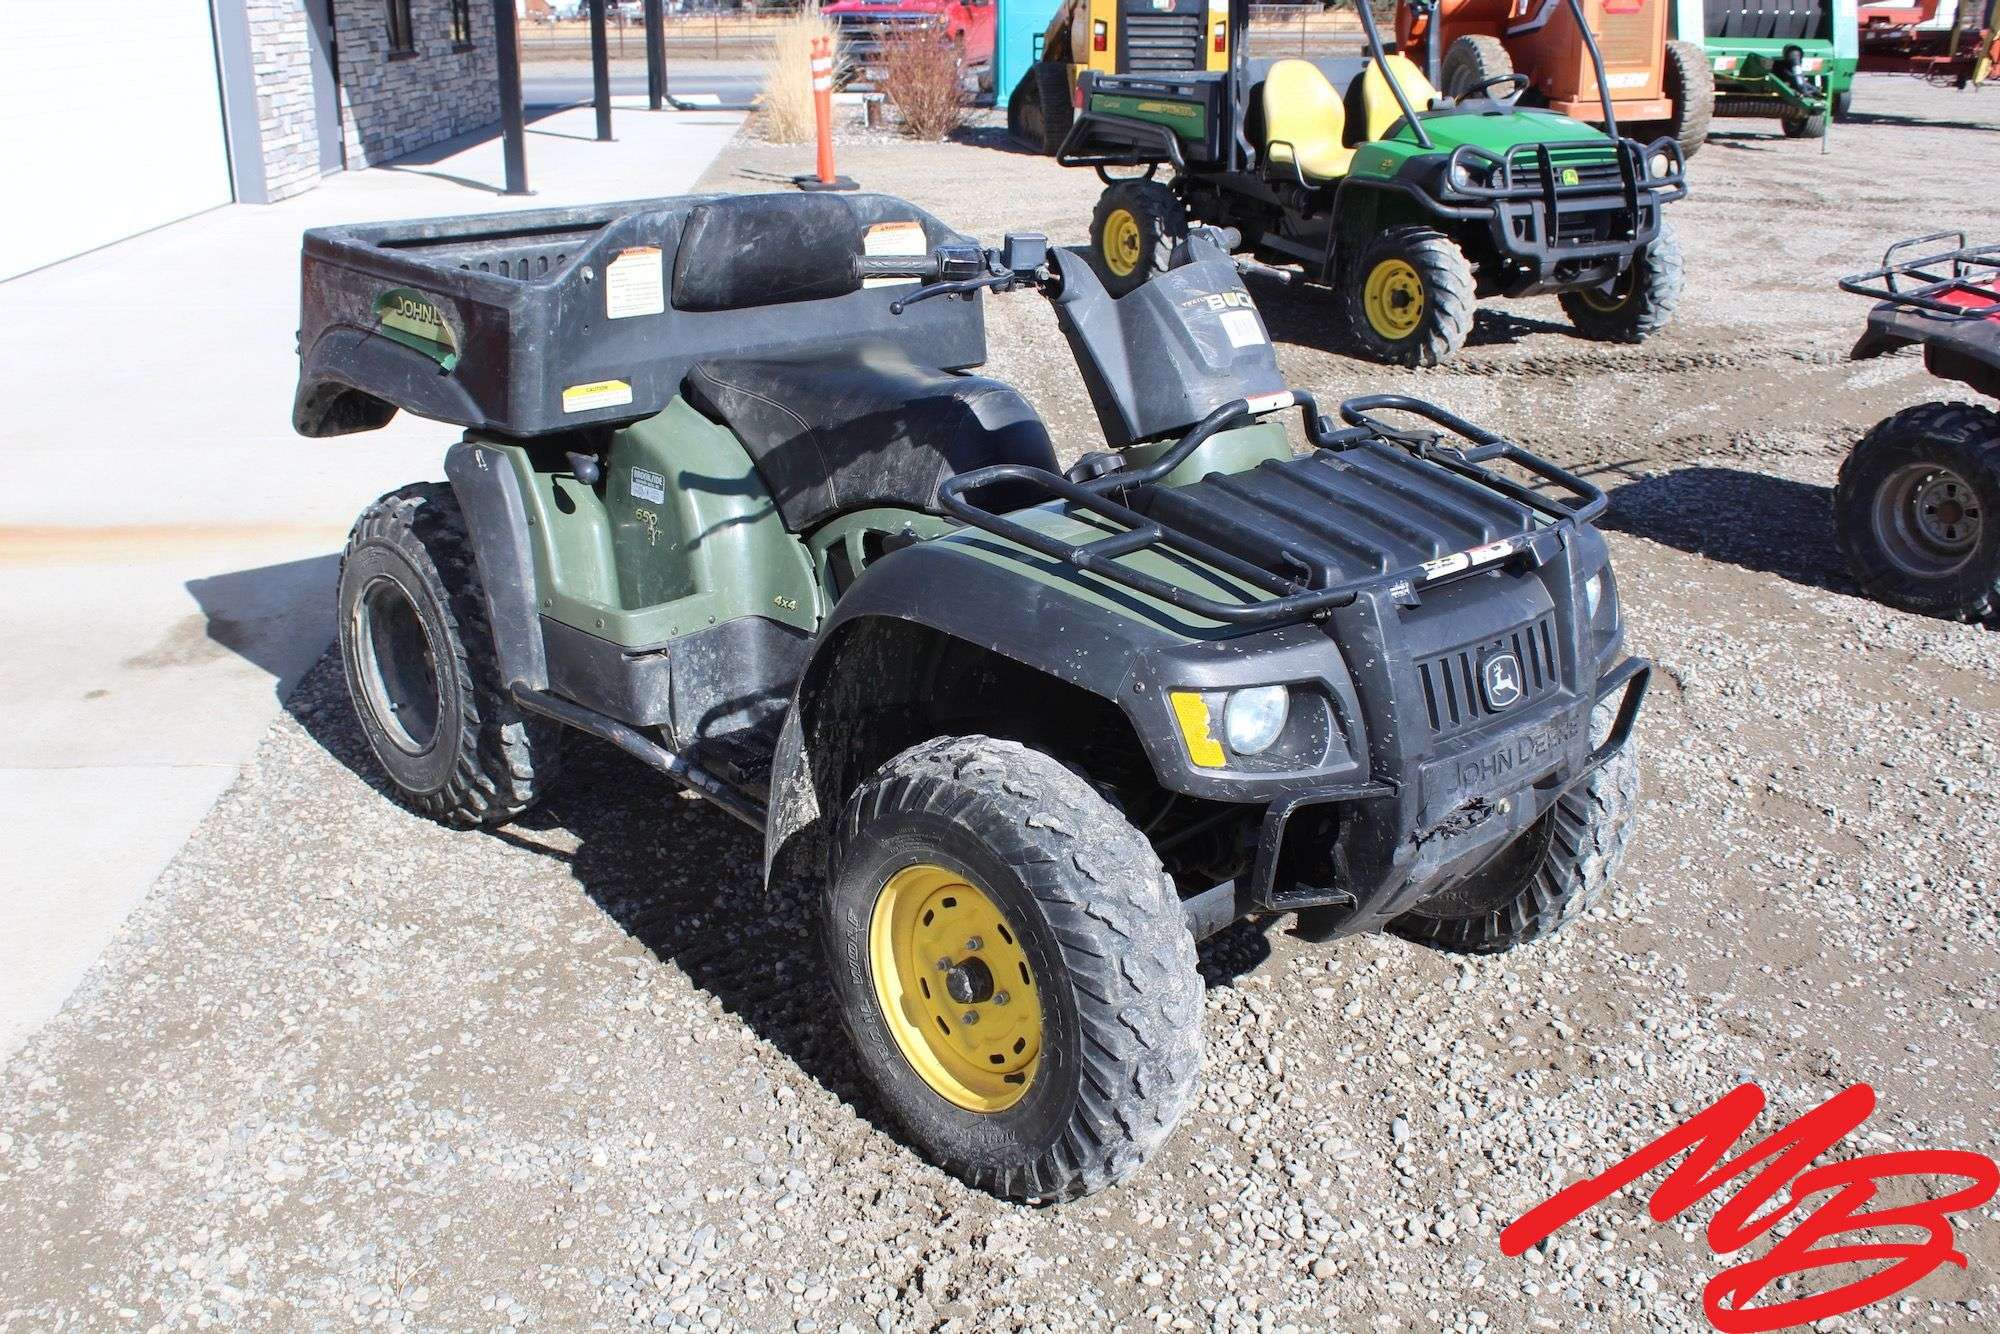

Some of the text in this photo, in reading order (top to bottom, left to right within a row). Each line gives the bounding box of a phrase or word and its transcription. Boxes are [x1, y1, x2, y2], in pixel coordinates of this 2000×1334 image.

[397, 296, 434, 324] JOHN
[635, 508, 657, 526] 650
[774, 594, 797, 611] 4x4
[1448, 714, 1580, 792] JOHN DEERE
[846, 906, 865, 985] WOLF
